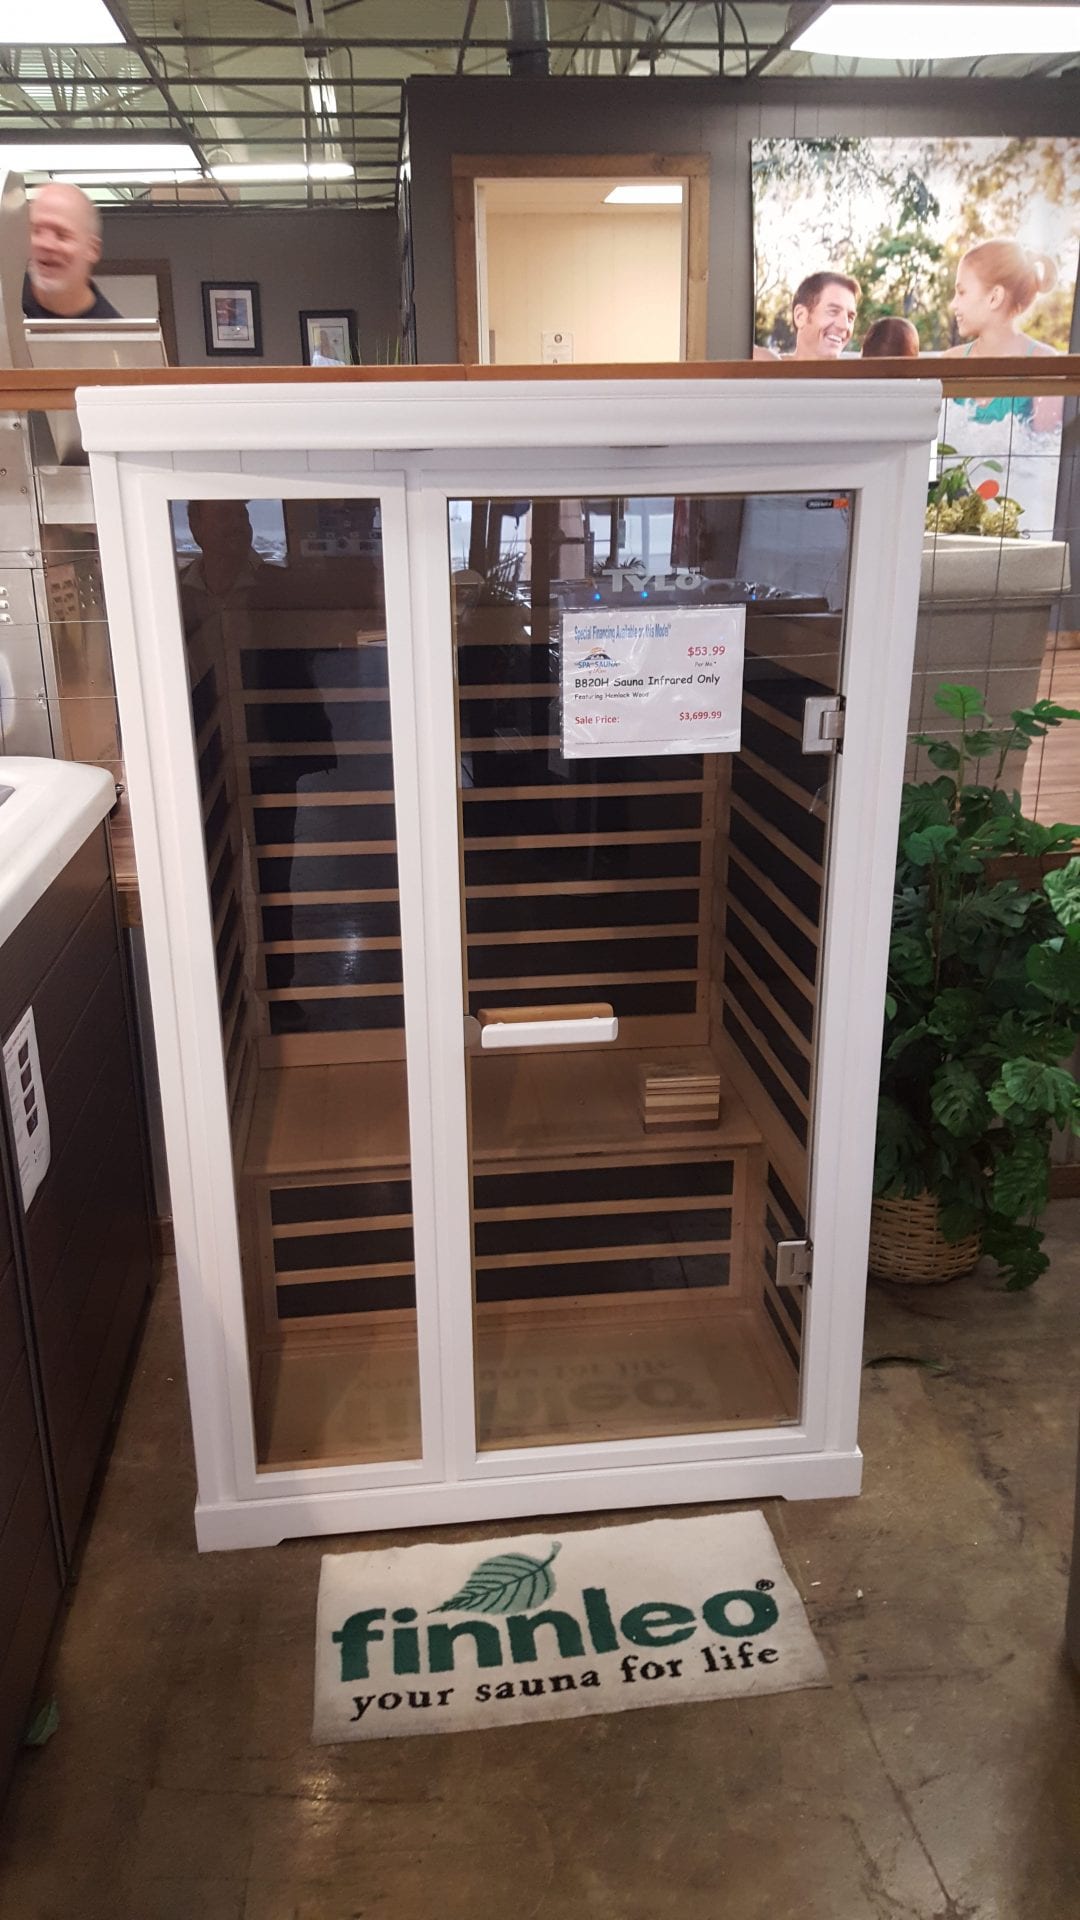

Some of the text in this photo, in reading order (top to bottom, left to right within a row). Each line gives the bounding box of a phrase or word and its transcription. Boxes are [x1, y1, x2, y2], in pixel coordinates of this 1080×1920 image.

[574, 625, 592, 643] Special
[592, 625, 615, 642] Financing
[687, 645, 726, 658] $53.99
[594, 660, 618, 668] SAUNA
[575, 673, 720, 688] B820H Sauna Infrared Only
[605, 691, 630, 699] Hemlock
[575, 715, 620, 725] Sale Price:
[679, 710, 722, 722] $3,699.99
[350, 1641, 779, 1721] your sauna for life
